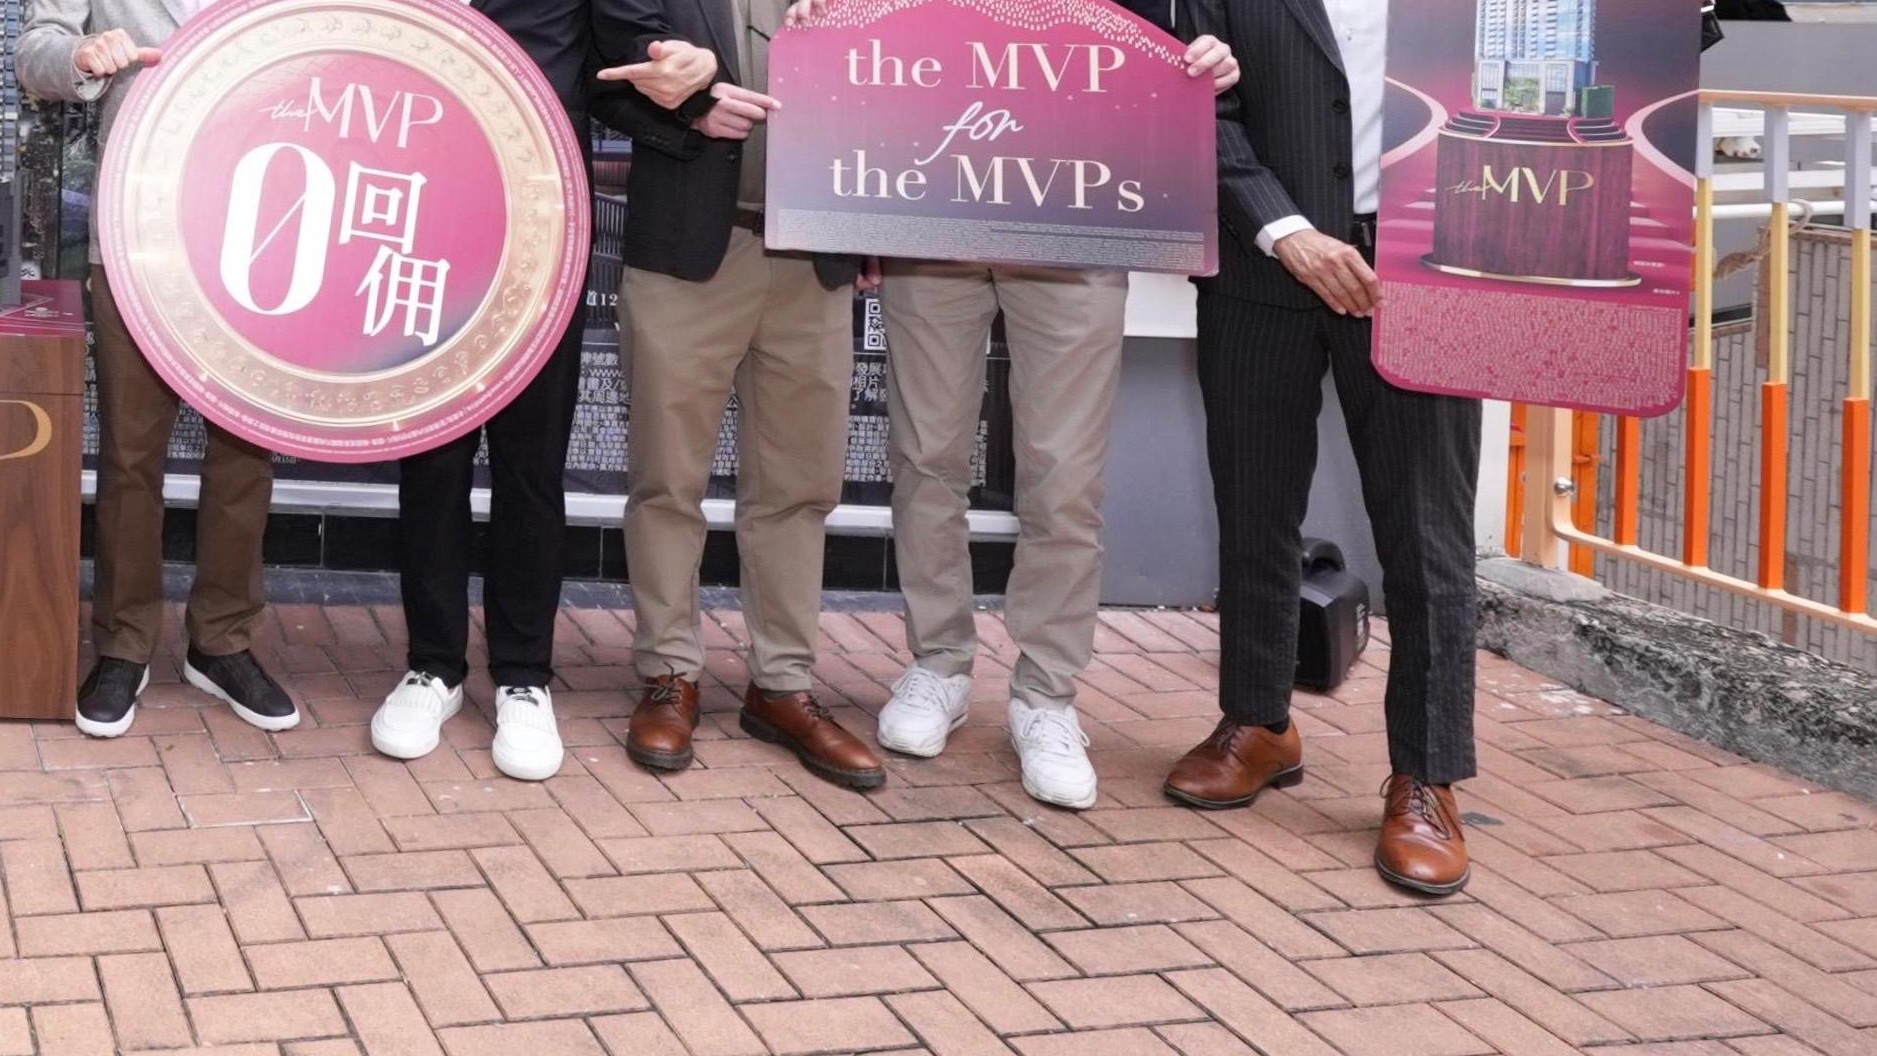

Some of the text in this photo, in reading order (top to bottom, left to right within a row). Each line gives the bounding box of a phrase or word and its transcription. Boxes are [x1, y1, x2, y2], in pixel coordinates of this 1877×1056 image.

[844, 39, 1126, 94] the MVP
[303, 76, 444, 149] MVP
[913, 100, 1025, 165] for
[827, 149, 1147, 214] the MVPs
[1480, 164, 1595, 207] MVP
